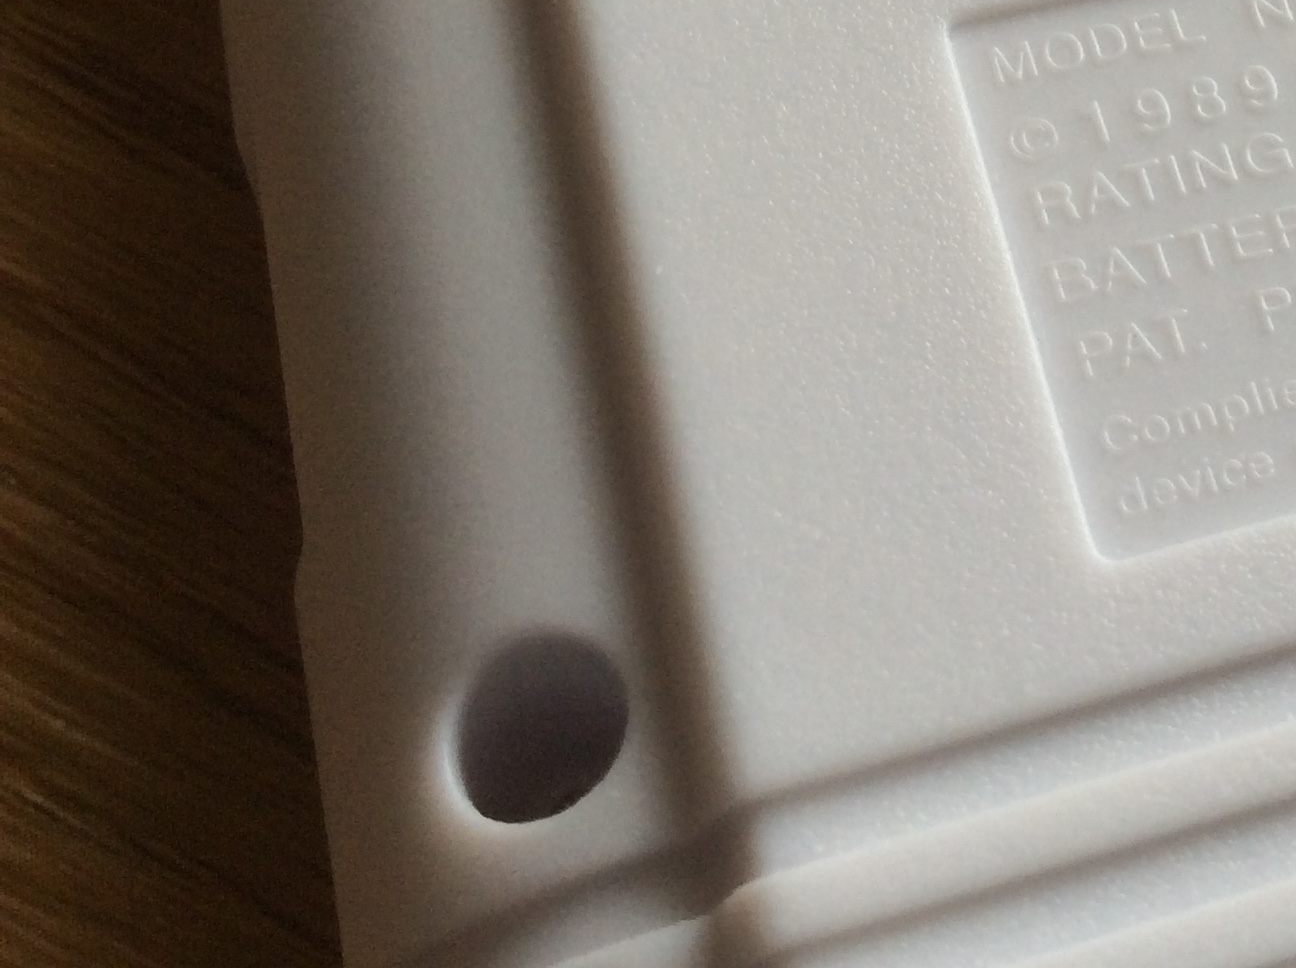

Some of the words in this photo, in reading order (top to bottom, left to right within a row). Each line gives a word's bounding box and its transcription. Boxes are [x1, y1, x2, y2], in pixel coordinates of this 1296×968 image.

[991, 8, 1206, 83] MODEL
[1034, 130, 1294, 226] RATING
[1077, 307, 1209, 378] PAT.
[1118, 450, 1277, 517] device
